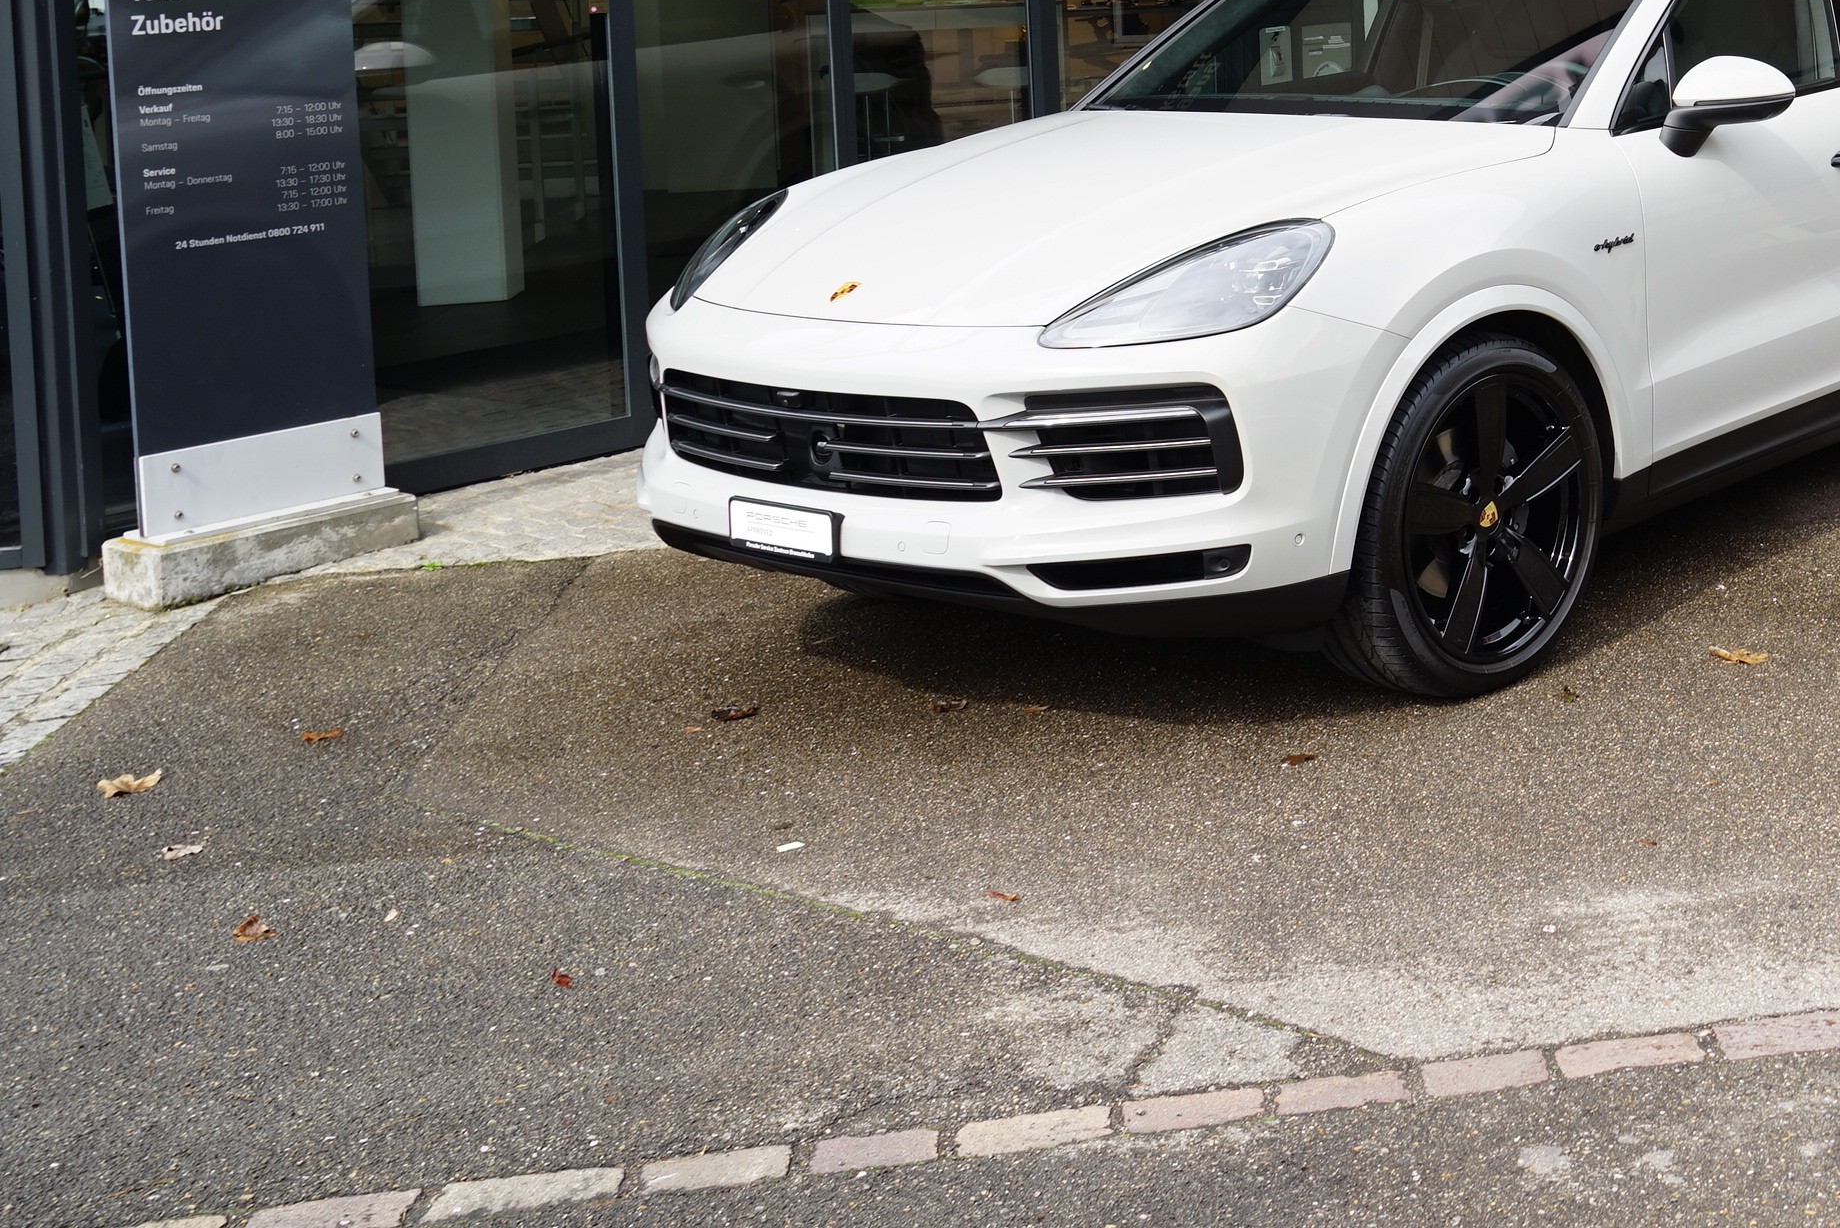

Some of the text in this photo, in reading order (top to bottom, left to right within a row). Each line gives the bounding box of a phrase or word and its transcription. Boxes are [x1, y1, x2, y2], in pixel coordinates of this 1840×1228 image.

[130, 11, 224, 37] Zubehör
[138, 83, 203, 96] Öffnungszeiten
[138, 103, 173, 114] Verkauf
[328, 101, 342, 110] Uhr
[140, 118, 172, 127] Montag
[183, 114, 211, 123] Freitag
[329, 113, 342, 122] Uhr
[330, 125, 344, 134] Uhr
[141, 142, 178, 152] Samstag
[332, 161, 346, 170] Uhr
[143, 166, 176, 178] Service
[333, 173, 347, 182] Uhr
[144, 179, 176, 190] Montag
[187, 174, 232, 186] Donnerstag
[334, 185, 348, 193] Uhr
[335, 197, 348, 205] Uhr
[146, 205, 175, 216] Freitag
[175, 223, 325, 250] 24 Stunden Notdienst 0800 724 911
[746, 511, 808, 528] PORSCHE
